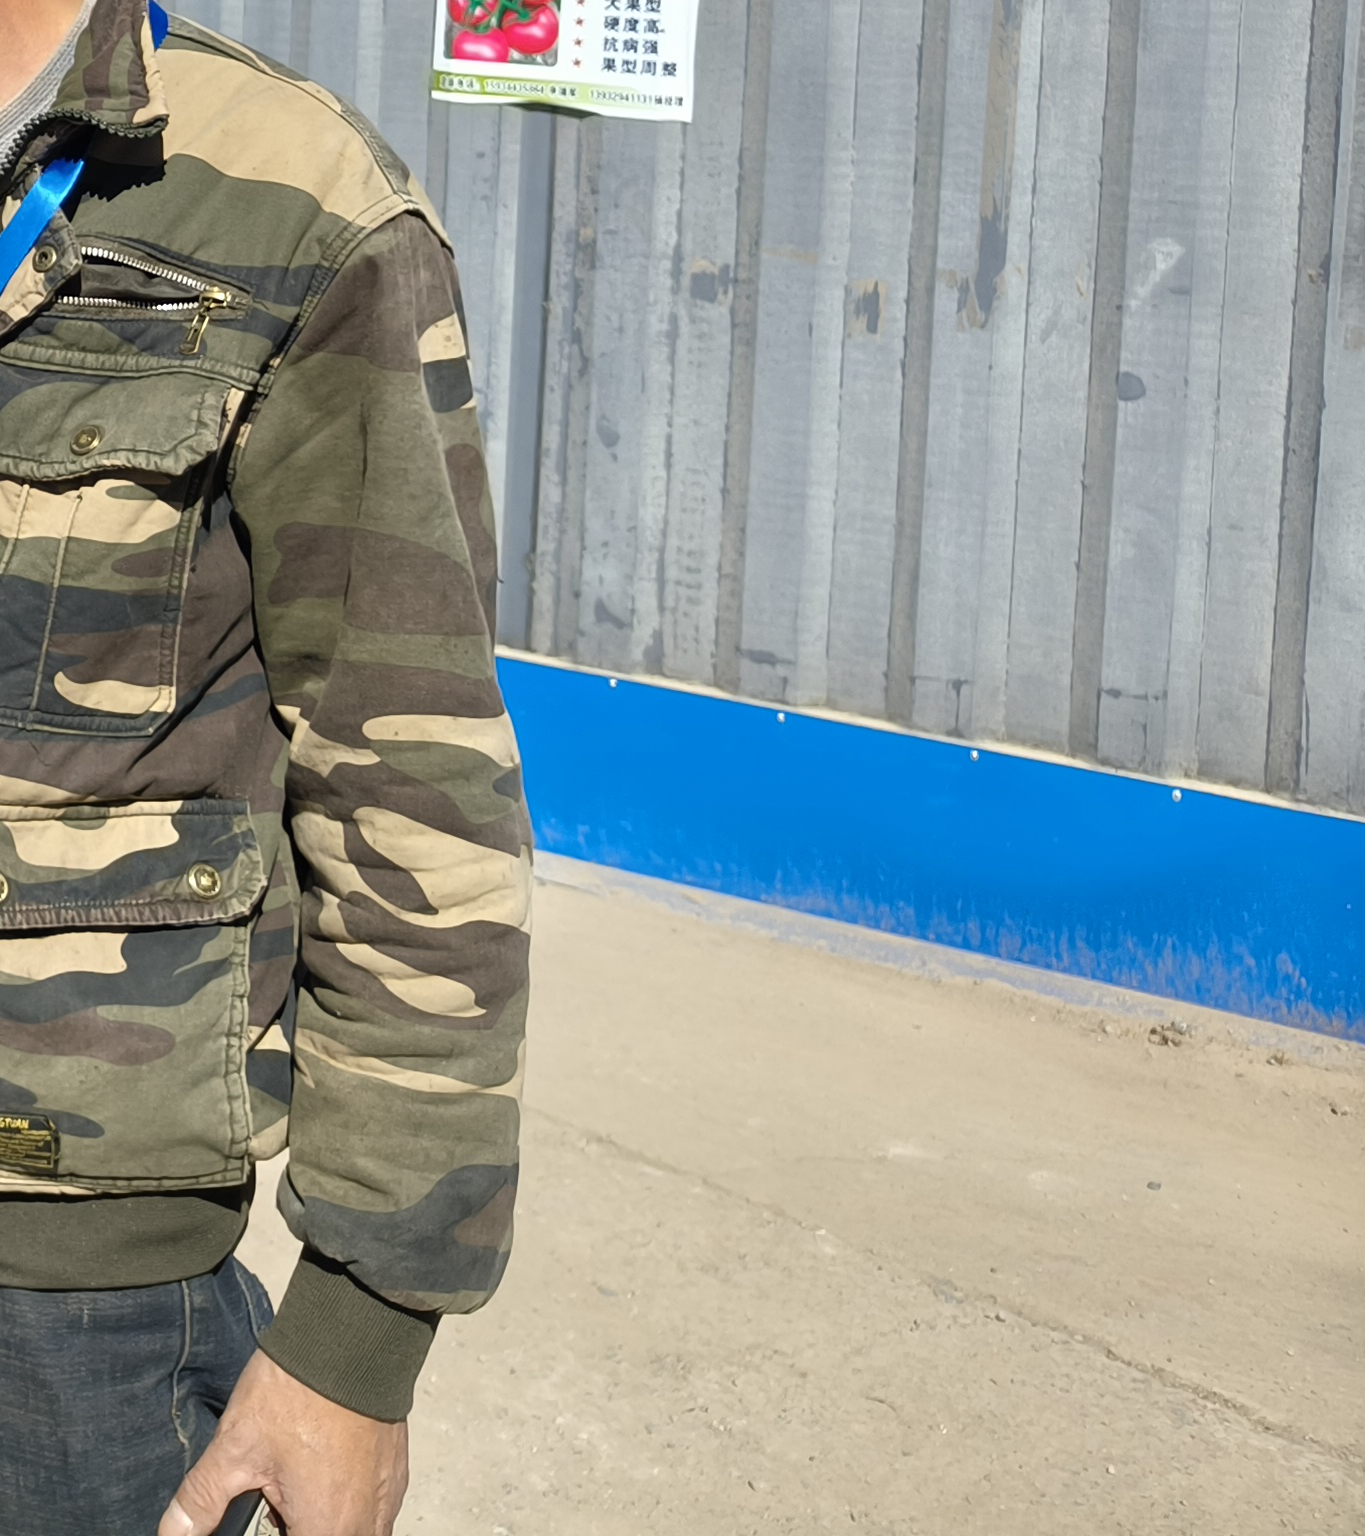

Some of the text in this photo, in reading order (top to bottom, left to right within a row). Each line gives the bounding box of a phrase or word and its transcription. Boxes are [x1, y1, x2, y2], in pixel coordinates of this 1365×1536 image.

[603, 36, 659, 56] 抗病强
[601, 57, 677, 77] 果型周整
